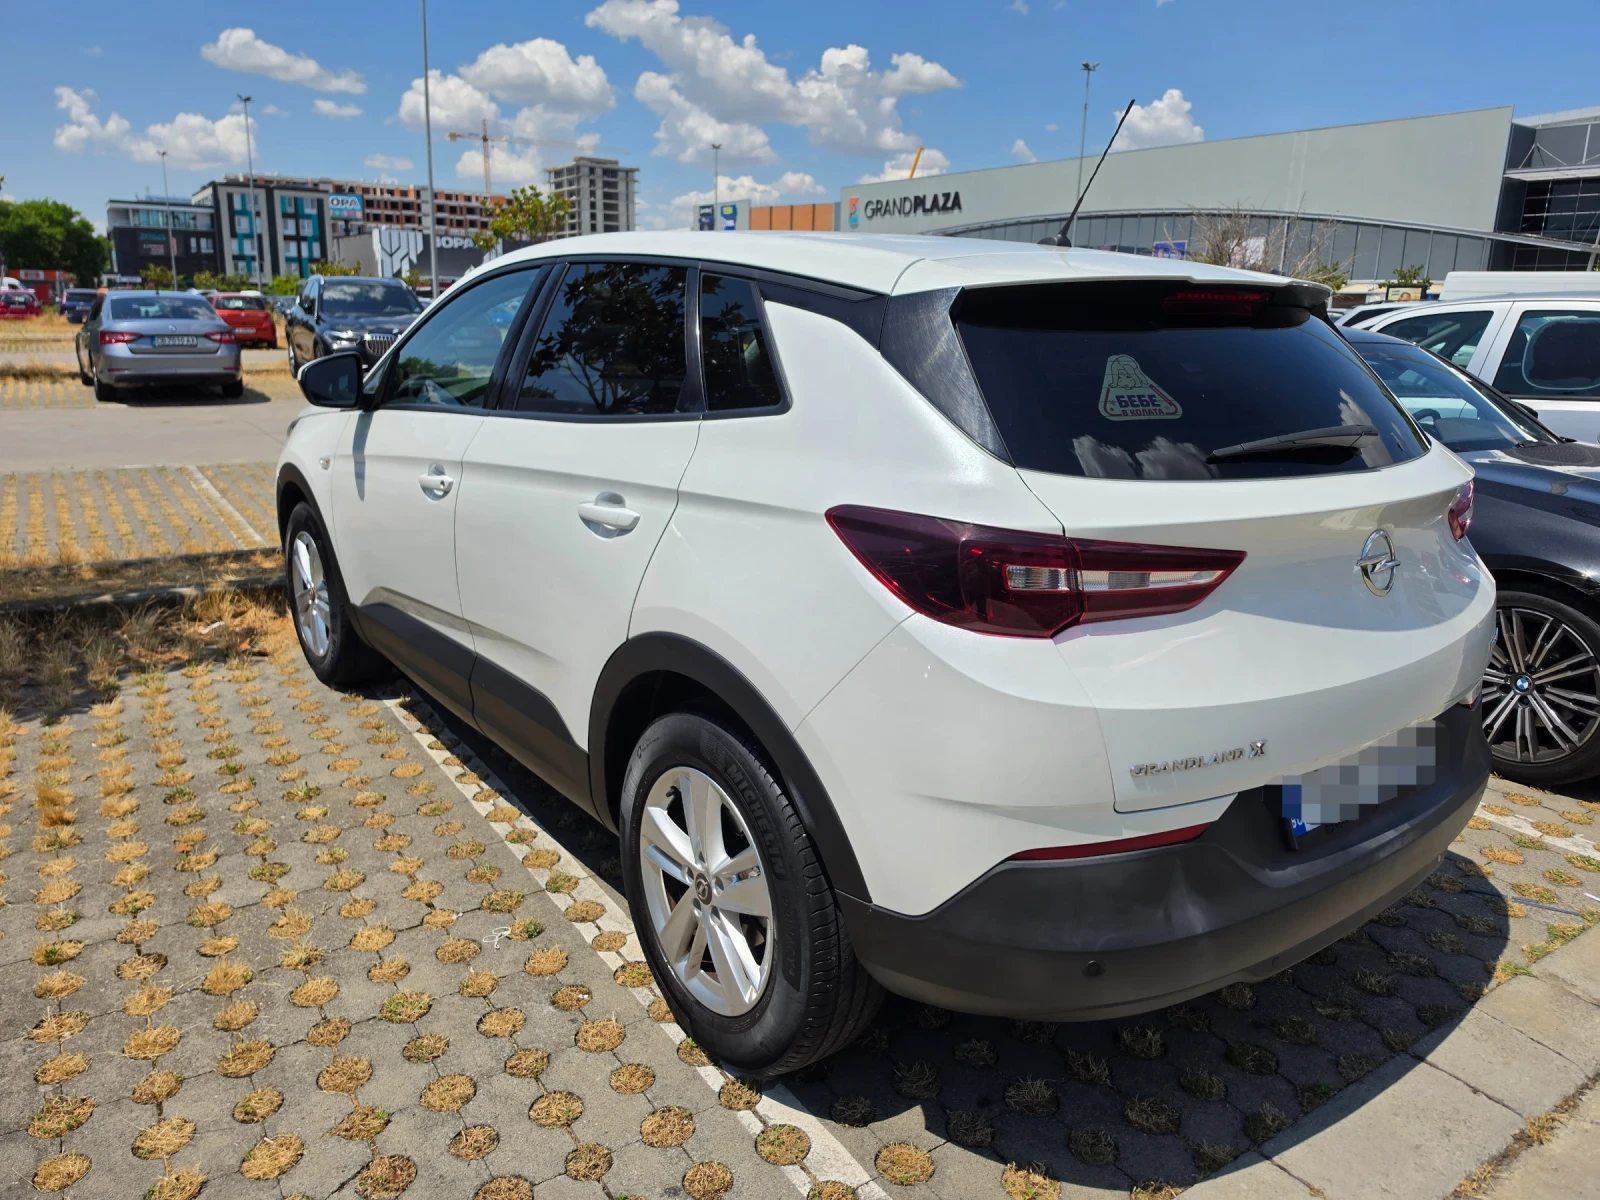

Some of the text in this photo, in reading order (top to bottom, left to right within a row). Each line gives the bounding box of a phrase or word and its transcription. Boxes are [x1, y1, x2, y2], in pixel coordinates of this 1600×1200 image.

[864, 191, 962, 220] GRANDPLAZA
[1116, 394, 1161, 407] БЕБЕ
[1130, 408, 1166, 416] КОЛАТА
[1130, 739, 1268, 777] GRANDLAND X
[725, 763, 786, 876] MICHELIN
